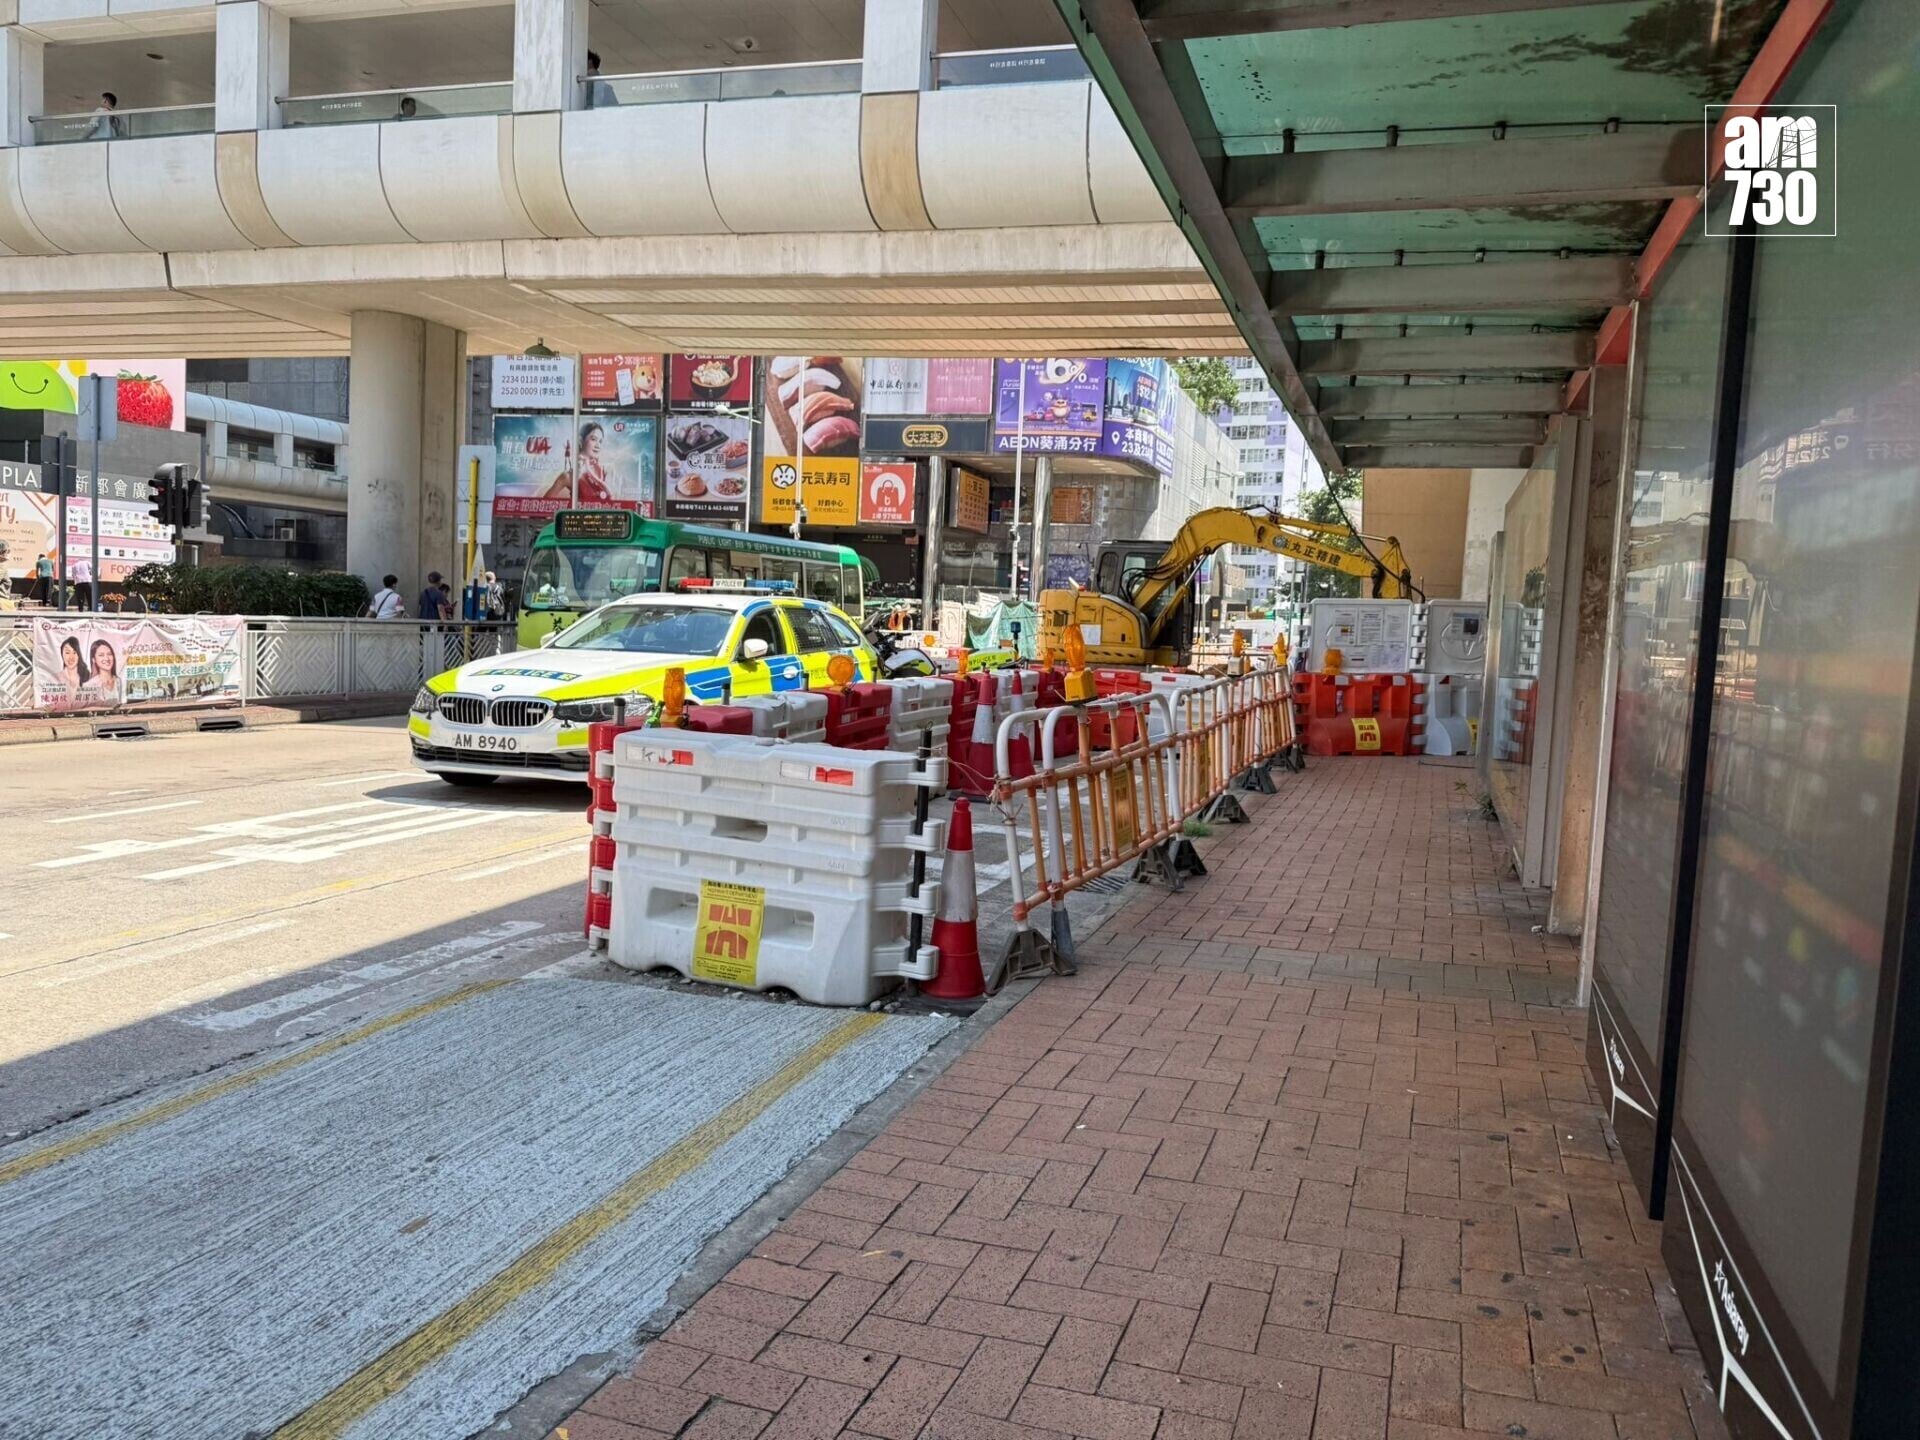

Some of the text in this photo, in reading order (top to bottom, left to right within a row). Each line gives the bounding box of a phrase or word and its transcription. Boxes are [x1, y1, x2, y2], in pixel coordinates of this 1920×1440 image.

[501, 376, 519, 384] 2234
[501, 388, 519, 396] 2520
[520, 388, 538, 396] 0009
[526, 436, 552, 455] UA
[999, 436, 1097, 451] AEON葵涌分行
[2, 466, 43, 489] PLA
[76, 473, 160, 500] 新都會廣
[110, 564, 137, 575] FOO
[454, 734, 517, 751] AM 8940
[1721, 1277, 1750, 1356] Asiaray
